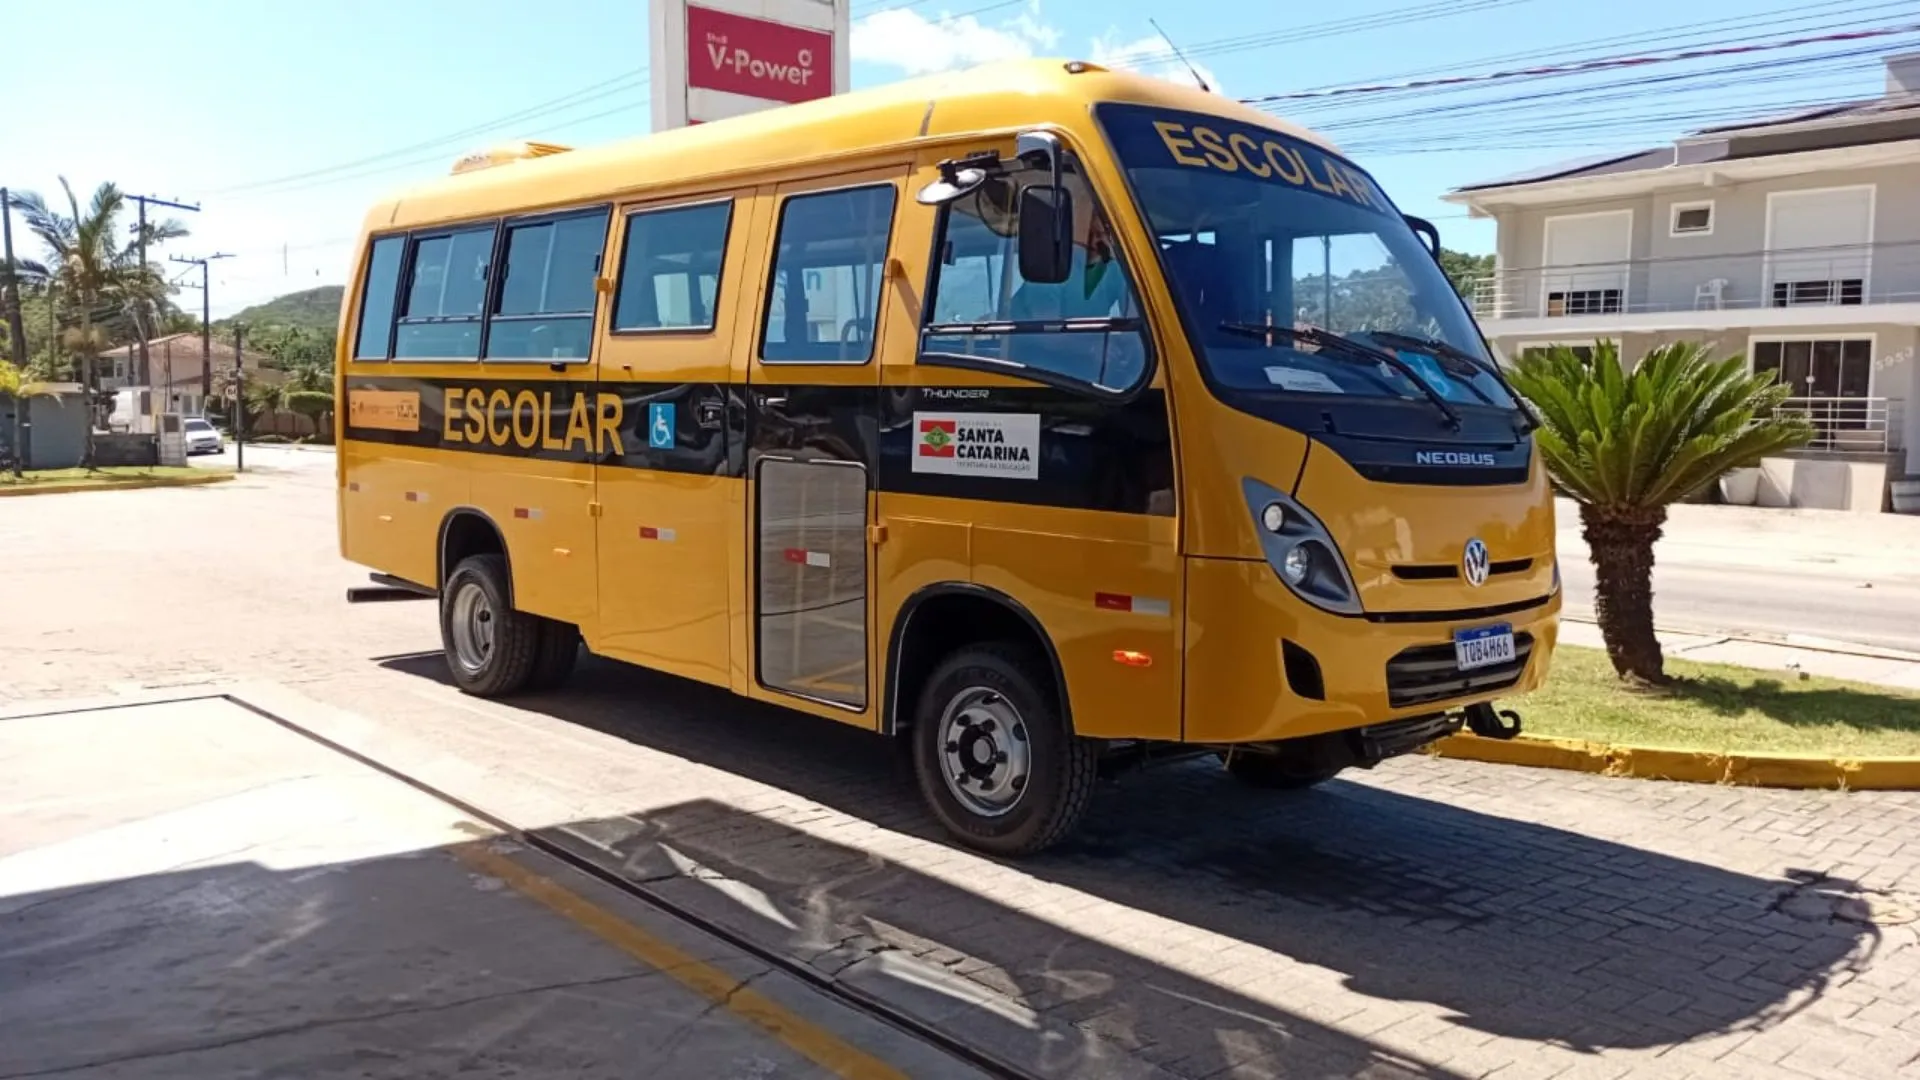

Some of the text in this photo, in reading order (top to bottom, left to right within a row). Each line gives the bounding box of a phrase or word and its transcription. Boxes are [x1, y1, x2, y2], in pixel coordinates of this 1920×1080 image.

[707, 43, 813, 85] V-Power
[1152, 121, 1386, 213] ESCOLAR
[922, 388, 990, 398] THUNDER
[443, 387, 625, 456] ESCOLAR
[957, 428, 1005, 443] SANTA
[956, 445, 1030, 462] CATARINA
[1416, 451, 1495, 466] NEOBUS
